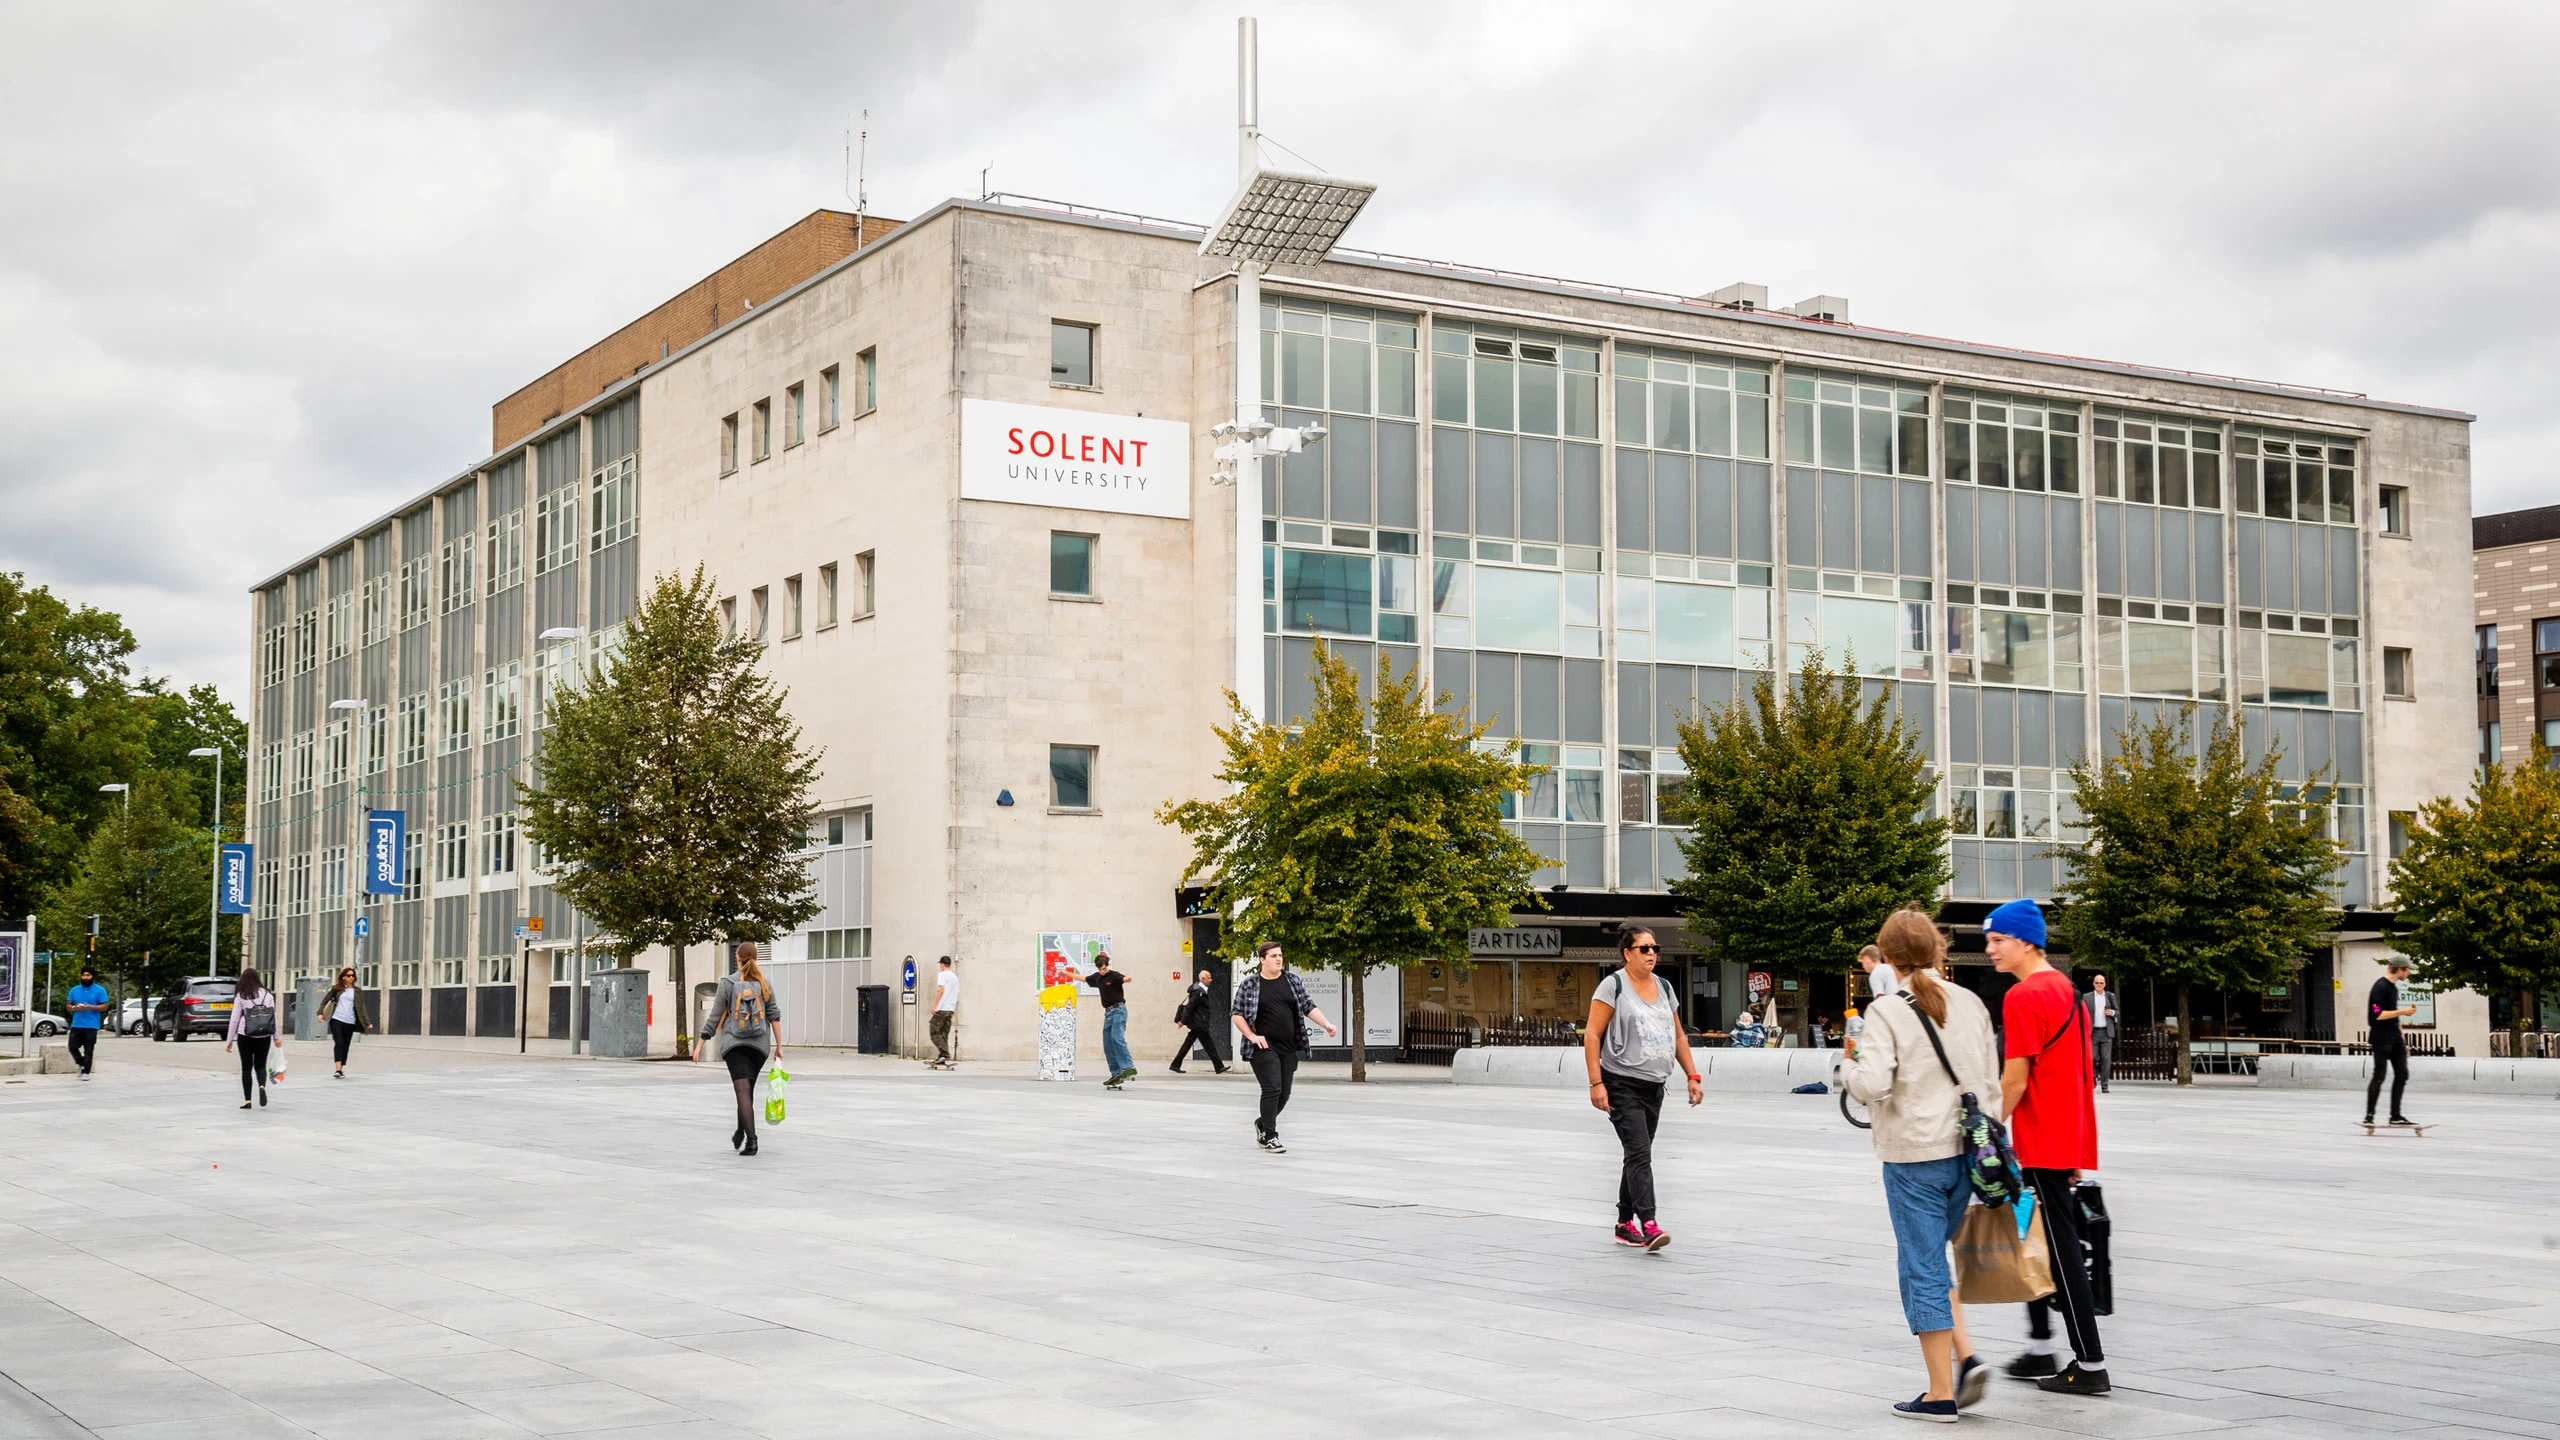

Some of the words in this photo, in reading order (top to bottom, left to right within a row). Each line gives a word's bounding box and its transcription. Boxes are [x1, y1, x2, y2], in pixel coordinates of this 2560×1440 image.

[1008, 427, 1148, 467] SOLENT
[1008, 464, 1148, 491] UNIVERSITY
[1477, 933, 1560, 950] ARTISAN
[1754, 974, 1764, 985] £3
